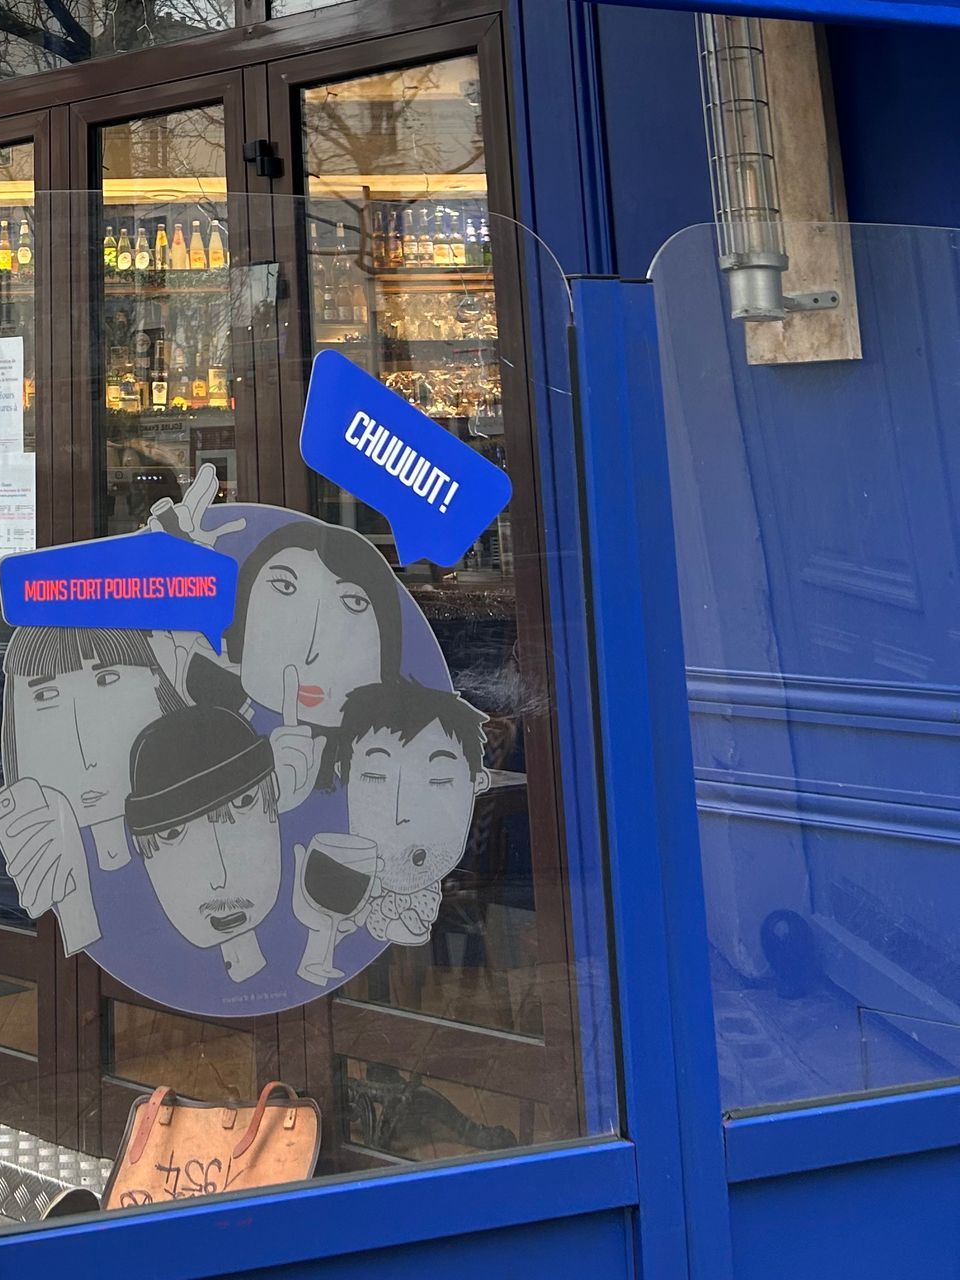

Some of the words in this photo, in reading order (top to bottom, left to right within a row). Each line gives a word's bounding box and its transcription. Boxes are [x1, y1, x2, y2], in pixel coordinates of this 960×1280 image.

[24, 579, 68, 602] MOINS
[70, 578, 102, 601] FORT
[105, 578, 140, 600] POUR
[143, 577, 164, 599] LES
[166, 576, 217, 598] VOISINS
